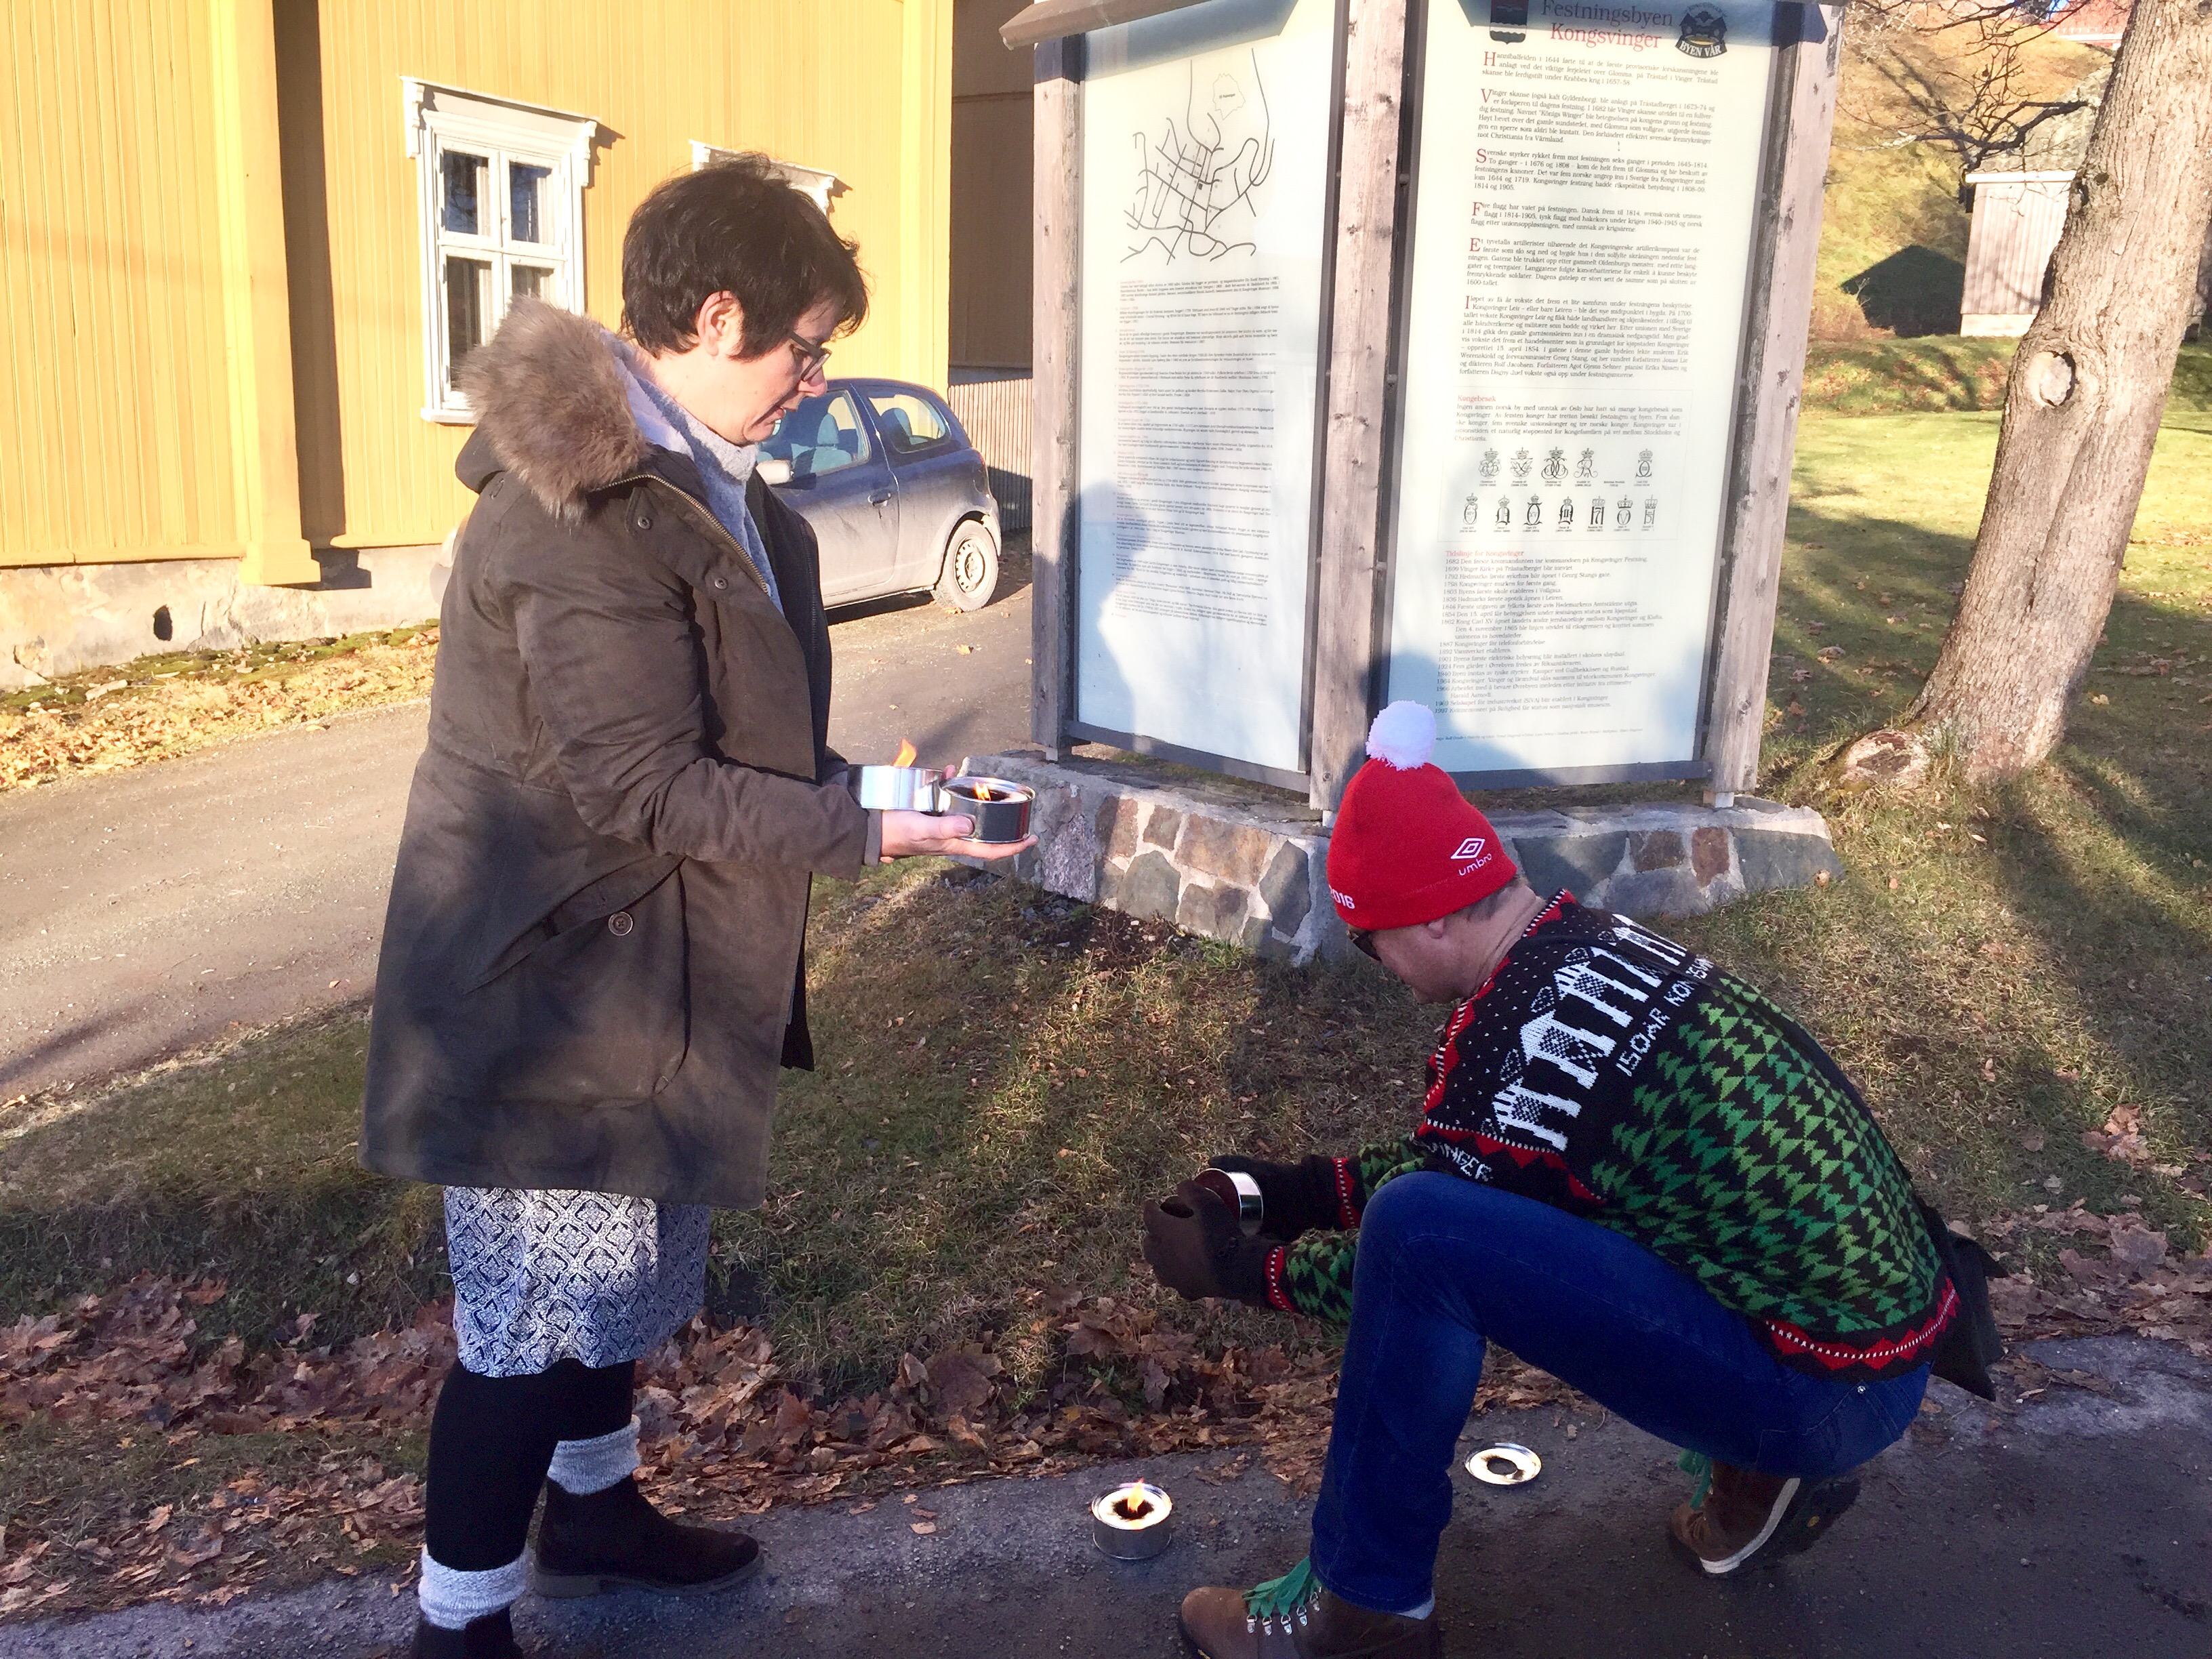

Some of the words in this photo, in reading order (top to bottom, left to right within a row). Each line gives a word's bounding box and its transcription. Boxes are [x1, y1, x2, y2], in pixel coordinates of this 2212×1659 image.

[1541, 0, 1673, 28] Festningsbyen
[1551, 22, 1662, 52] Kongsvinger
[1679, 40, 1702, 57] BYEN
[1458, 853, 1492, 876] umbro
